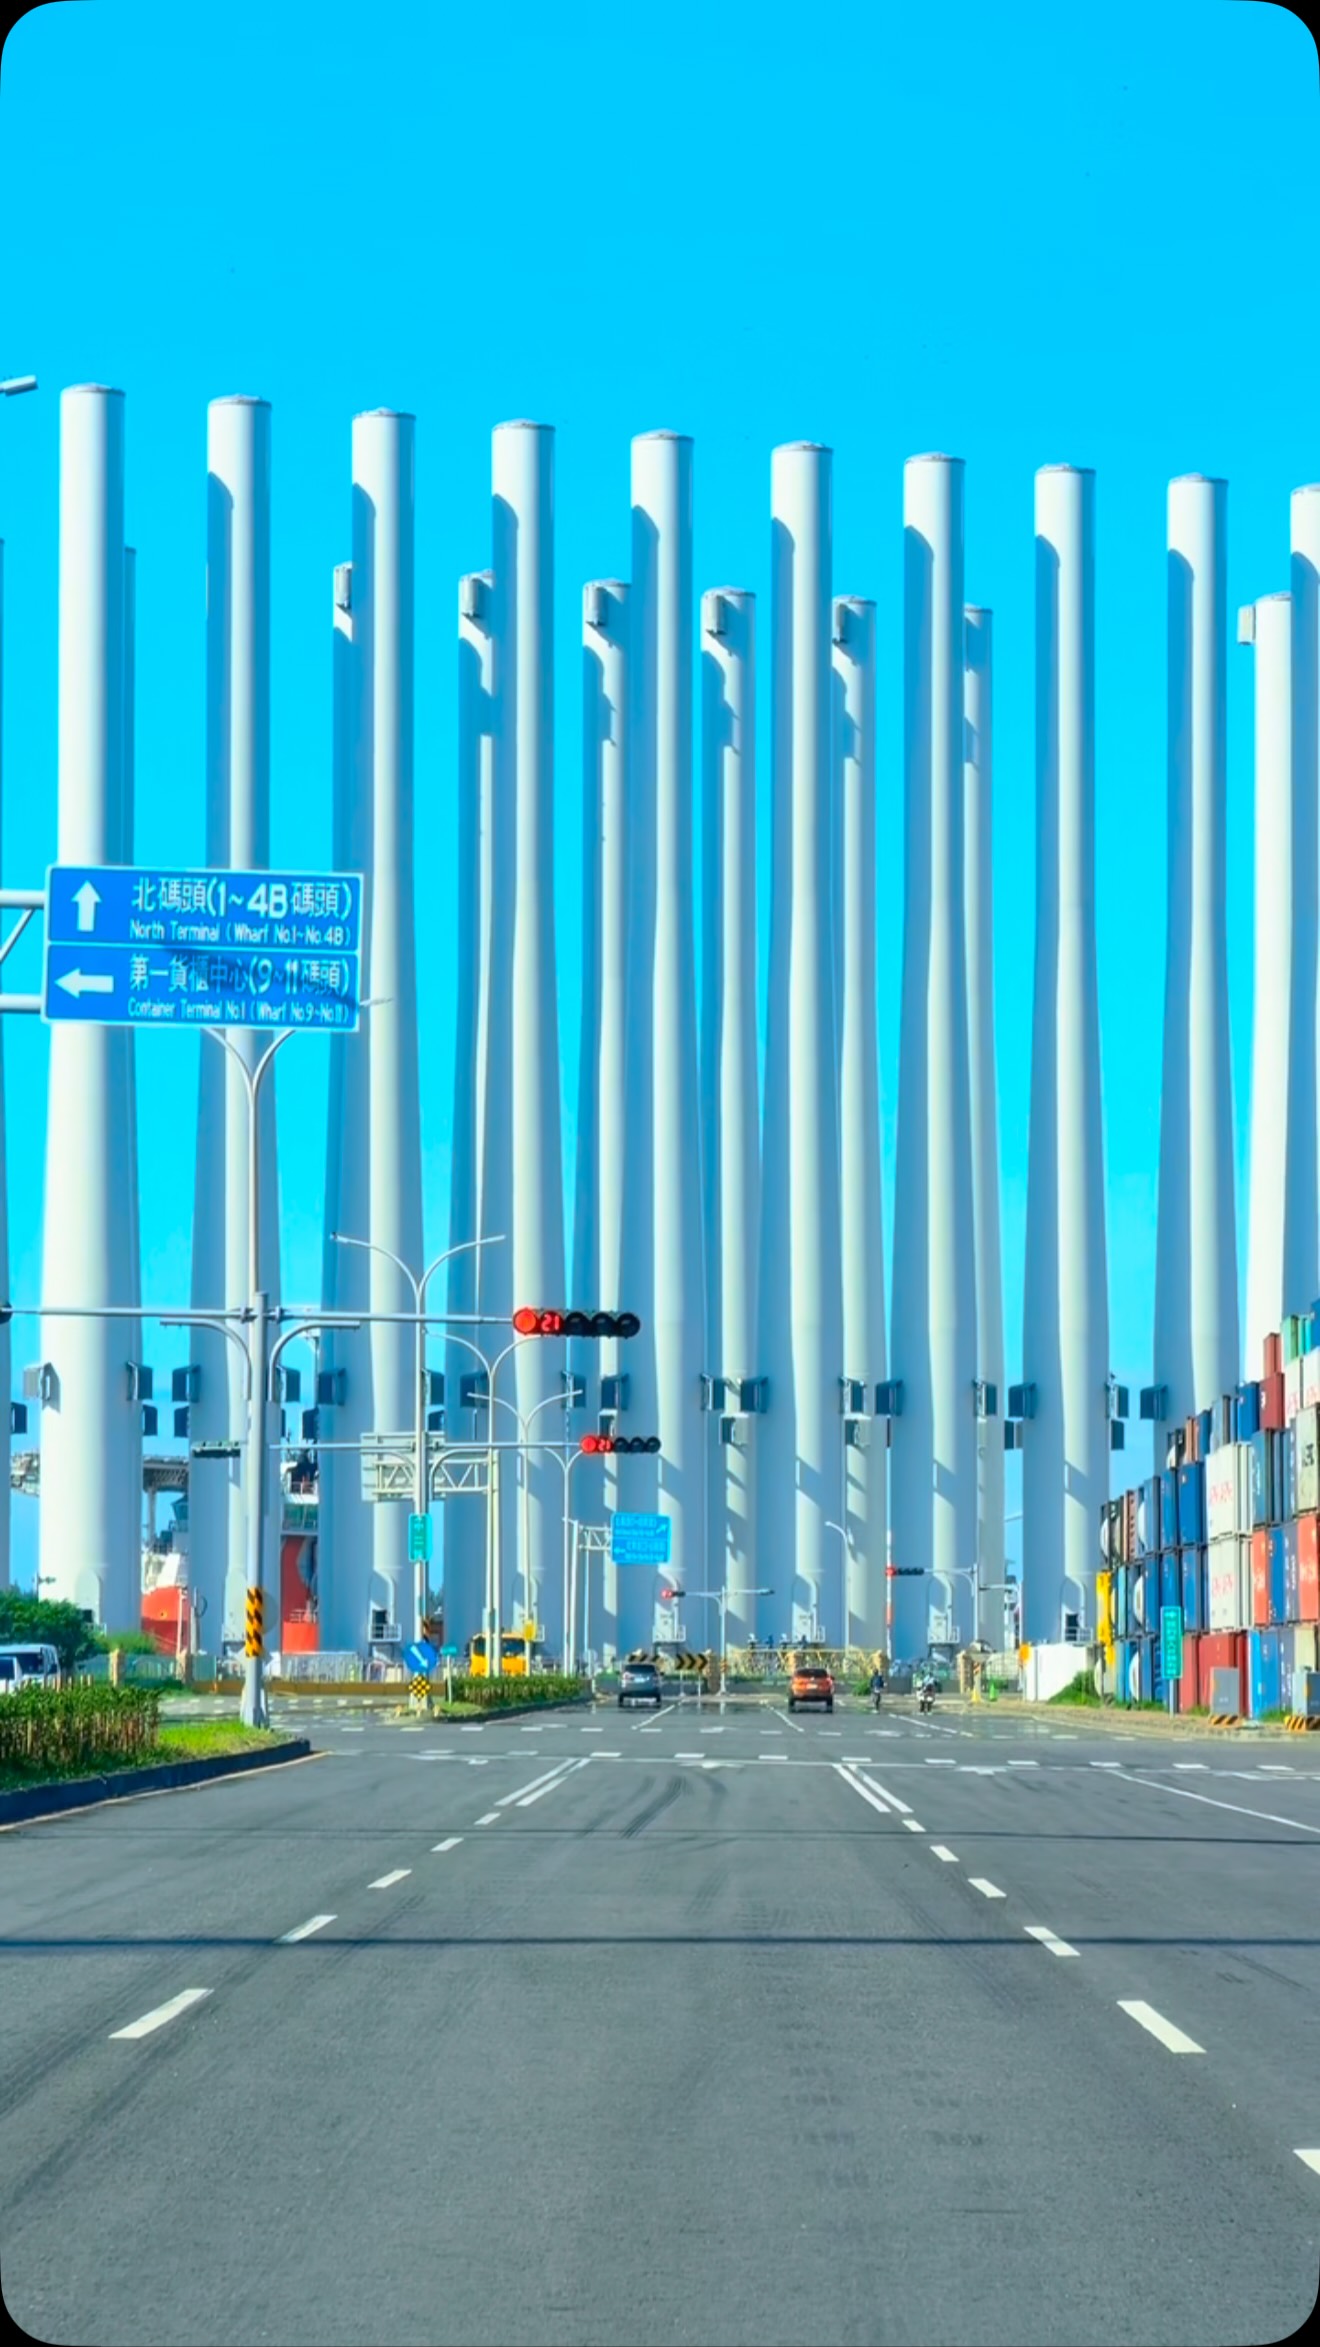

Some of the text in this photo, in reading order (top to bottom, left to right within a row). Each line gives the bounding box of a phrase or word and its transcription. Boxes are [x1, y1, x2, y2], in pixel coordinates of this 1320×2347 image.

[130, 918, 165, 940] North
[170, 920, 220, 942] Terminal
[127, 996, 176, 1018] Container
[180, 998, 222, 1019] Terminal
[540, 1315, 561, 1332] 21
[599, 1439, 611, 1450] 21
